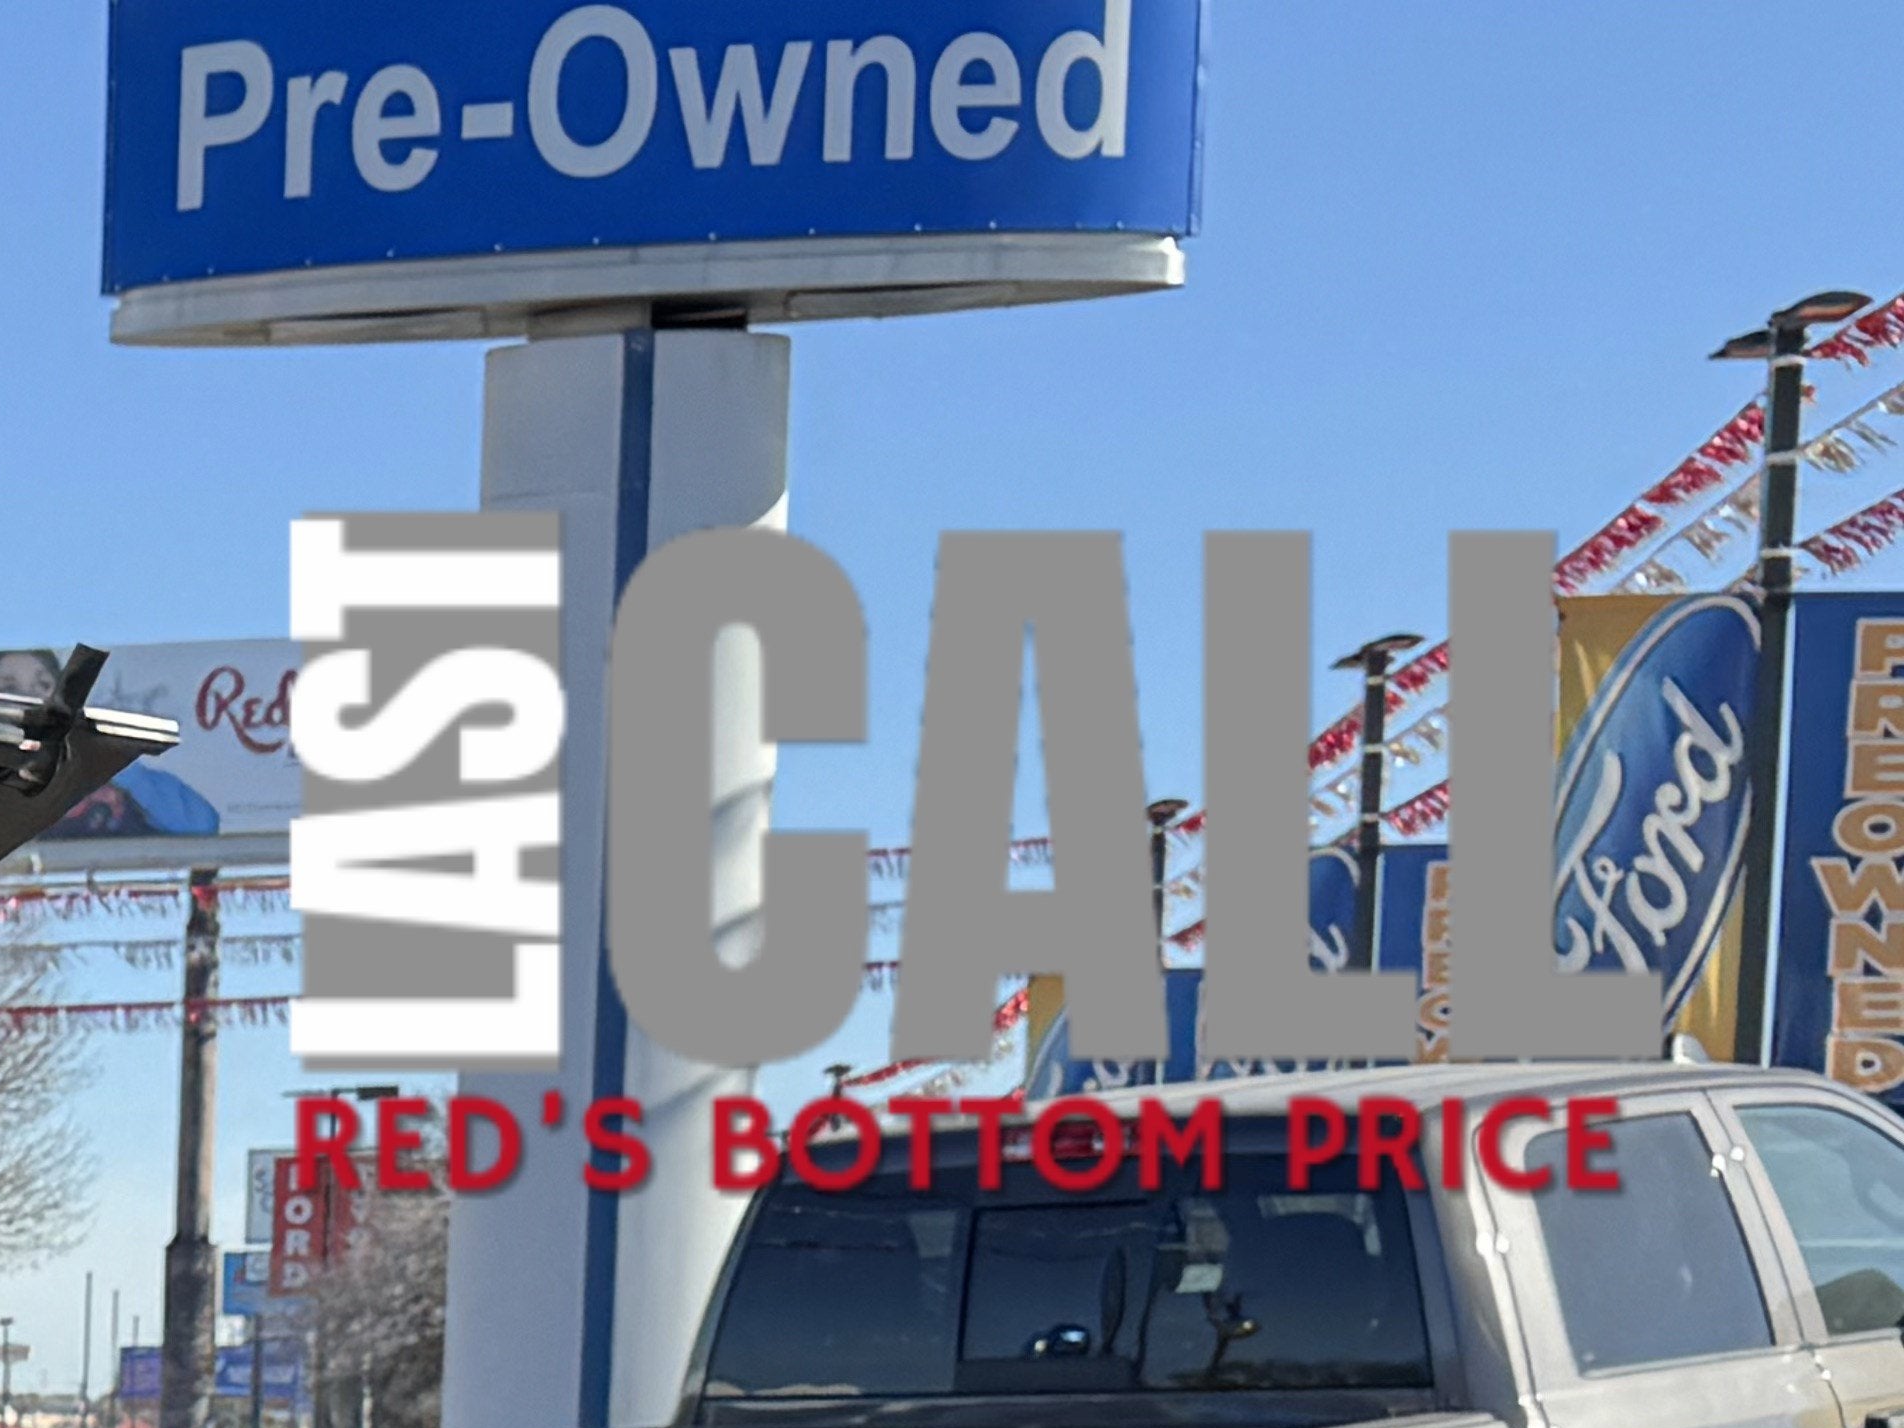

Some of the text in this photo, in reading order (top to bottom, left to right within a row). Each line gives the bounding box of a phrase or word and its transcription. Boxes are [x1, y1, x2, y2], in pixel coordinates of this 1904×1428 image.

[176, 0, 1130, 212] Pre-Owned
[1555, 677, 1745, 974] Ford
[282, 1158, 315, 1290] ORD
